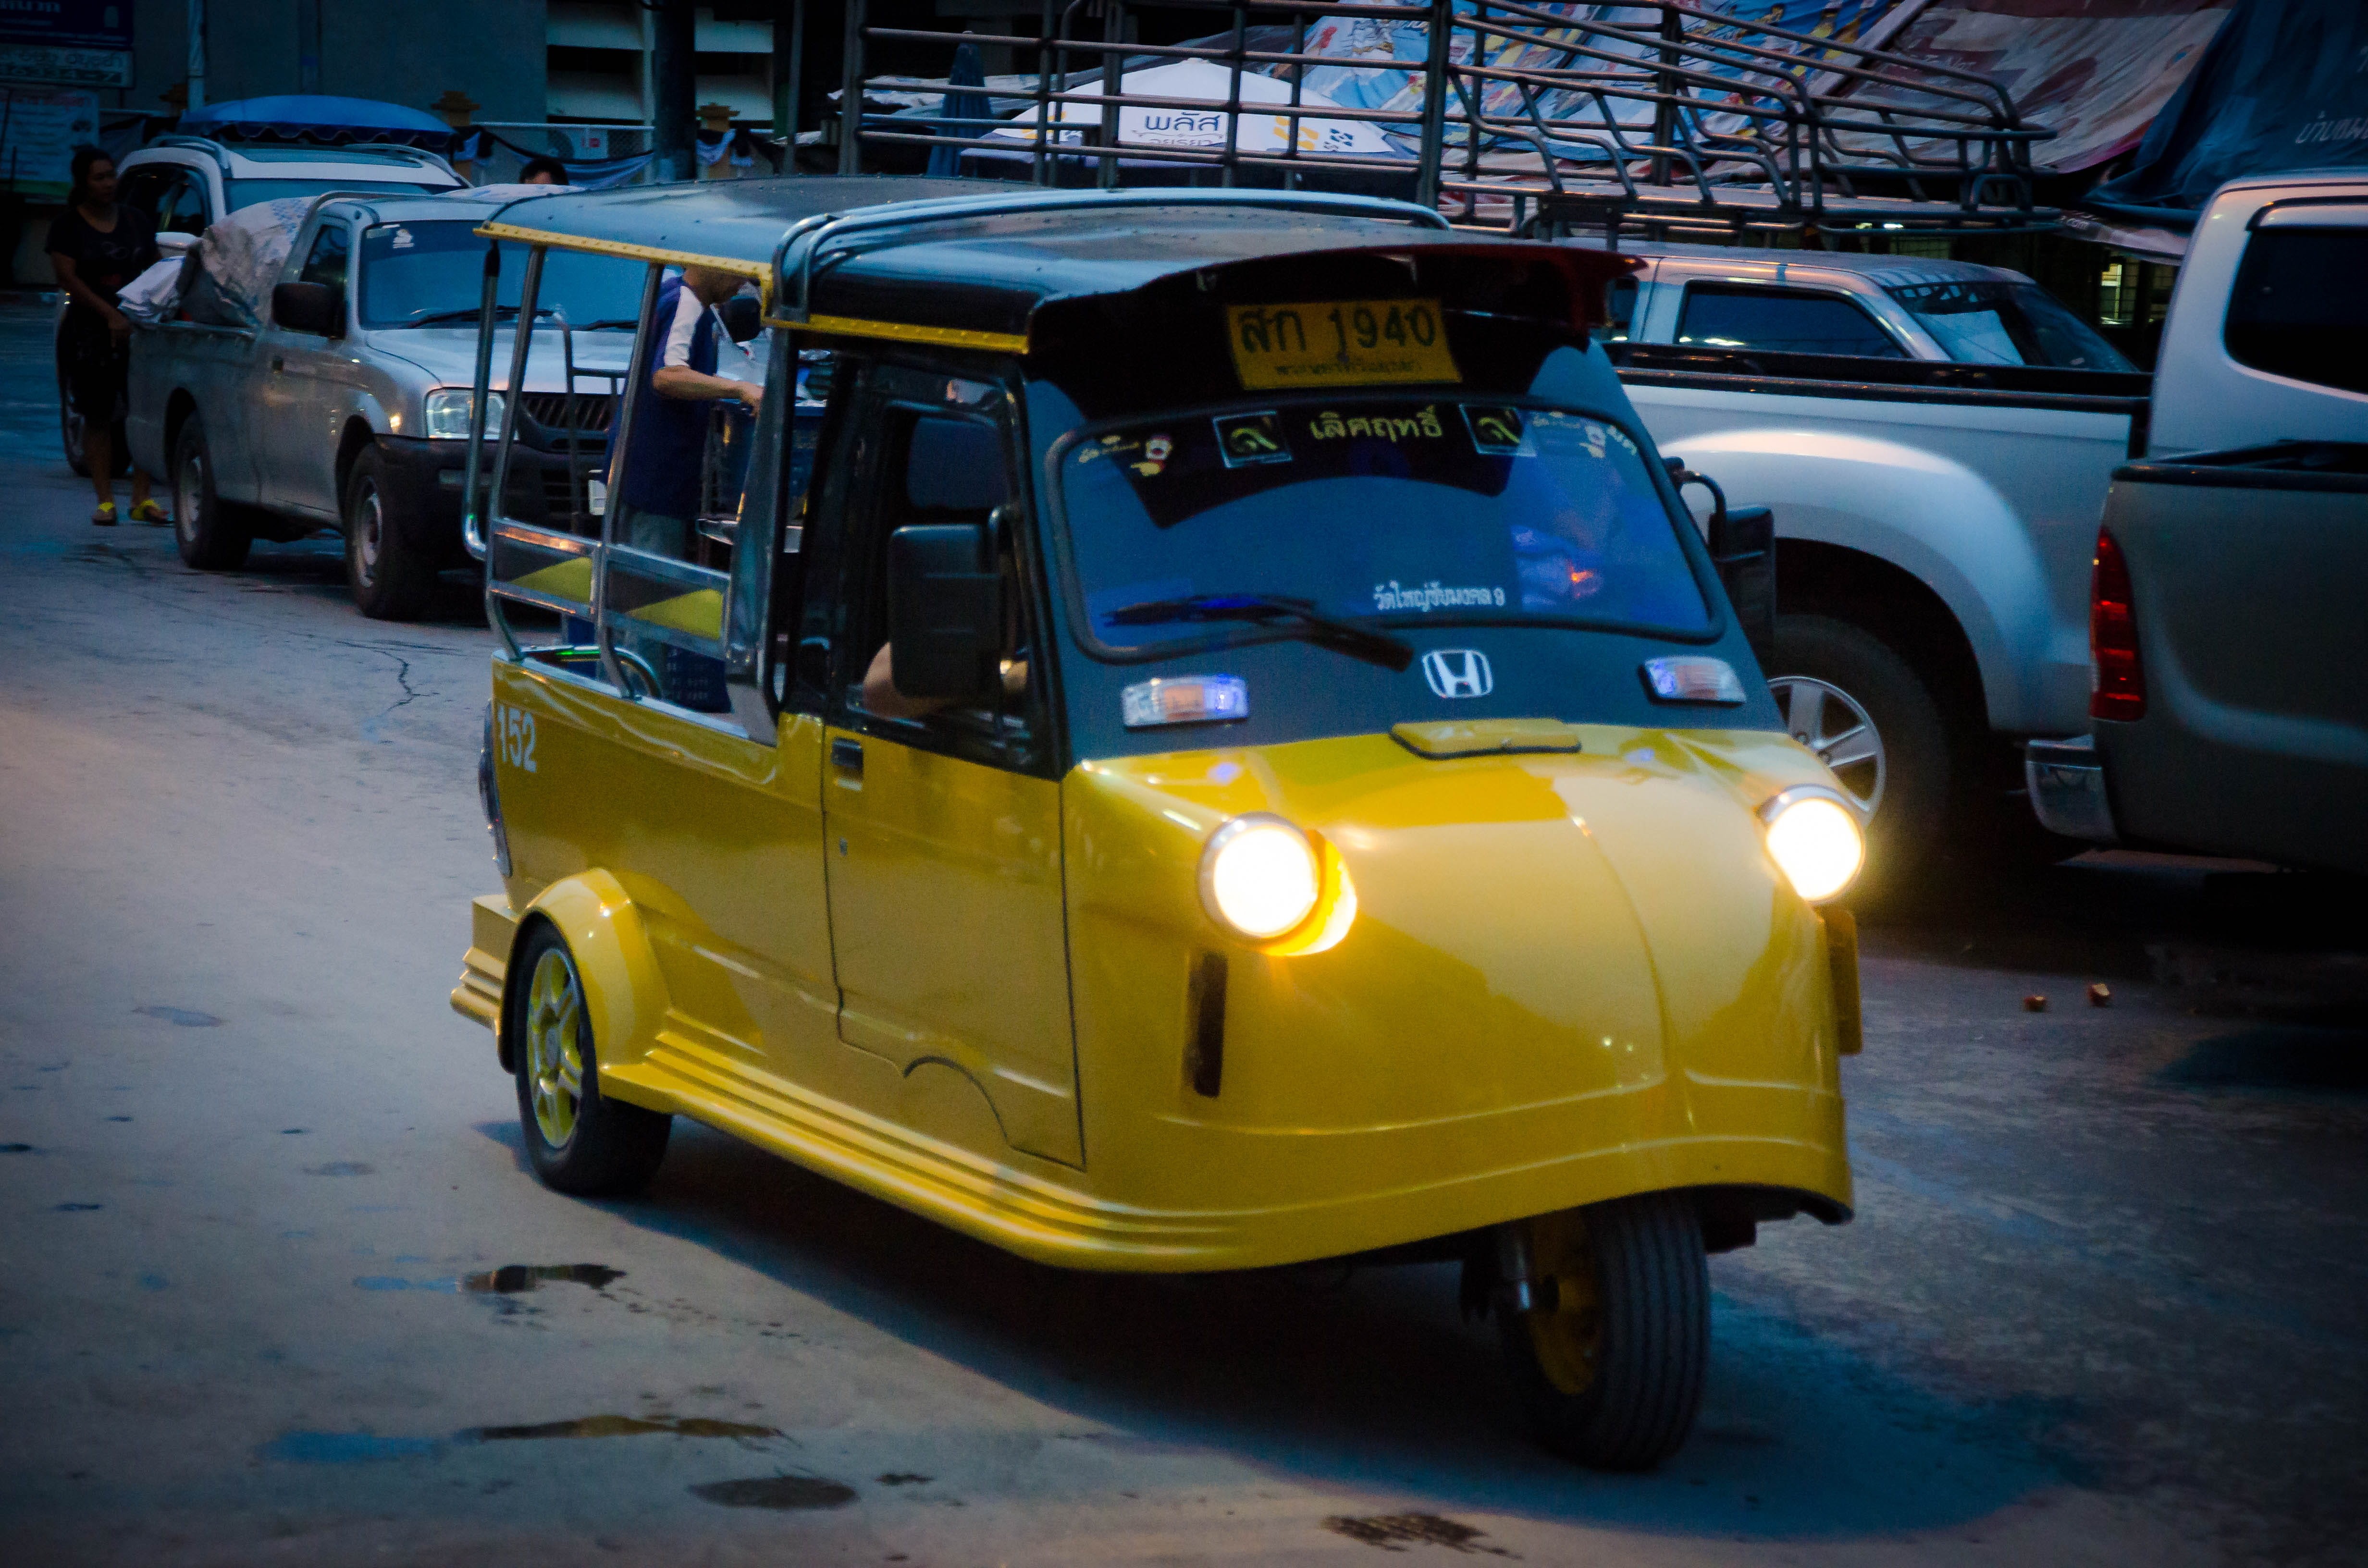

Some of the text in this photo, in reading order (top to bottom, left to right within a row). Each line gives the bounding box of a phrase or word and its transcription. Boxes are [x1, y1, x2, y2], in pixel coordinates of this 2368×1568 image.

[1146, 112, 1221, 131] พลัส
[1328, 305, 1436, 355] 1940
[497, 704, 537, 773] 152
